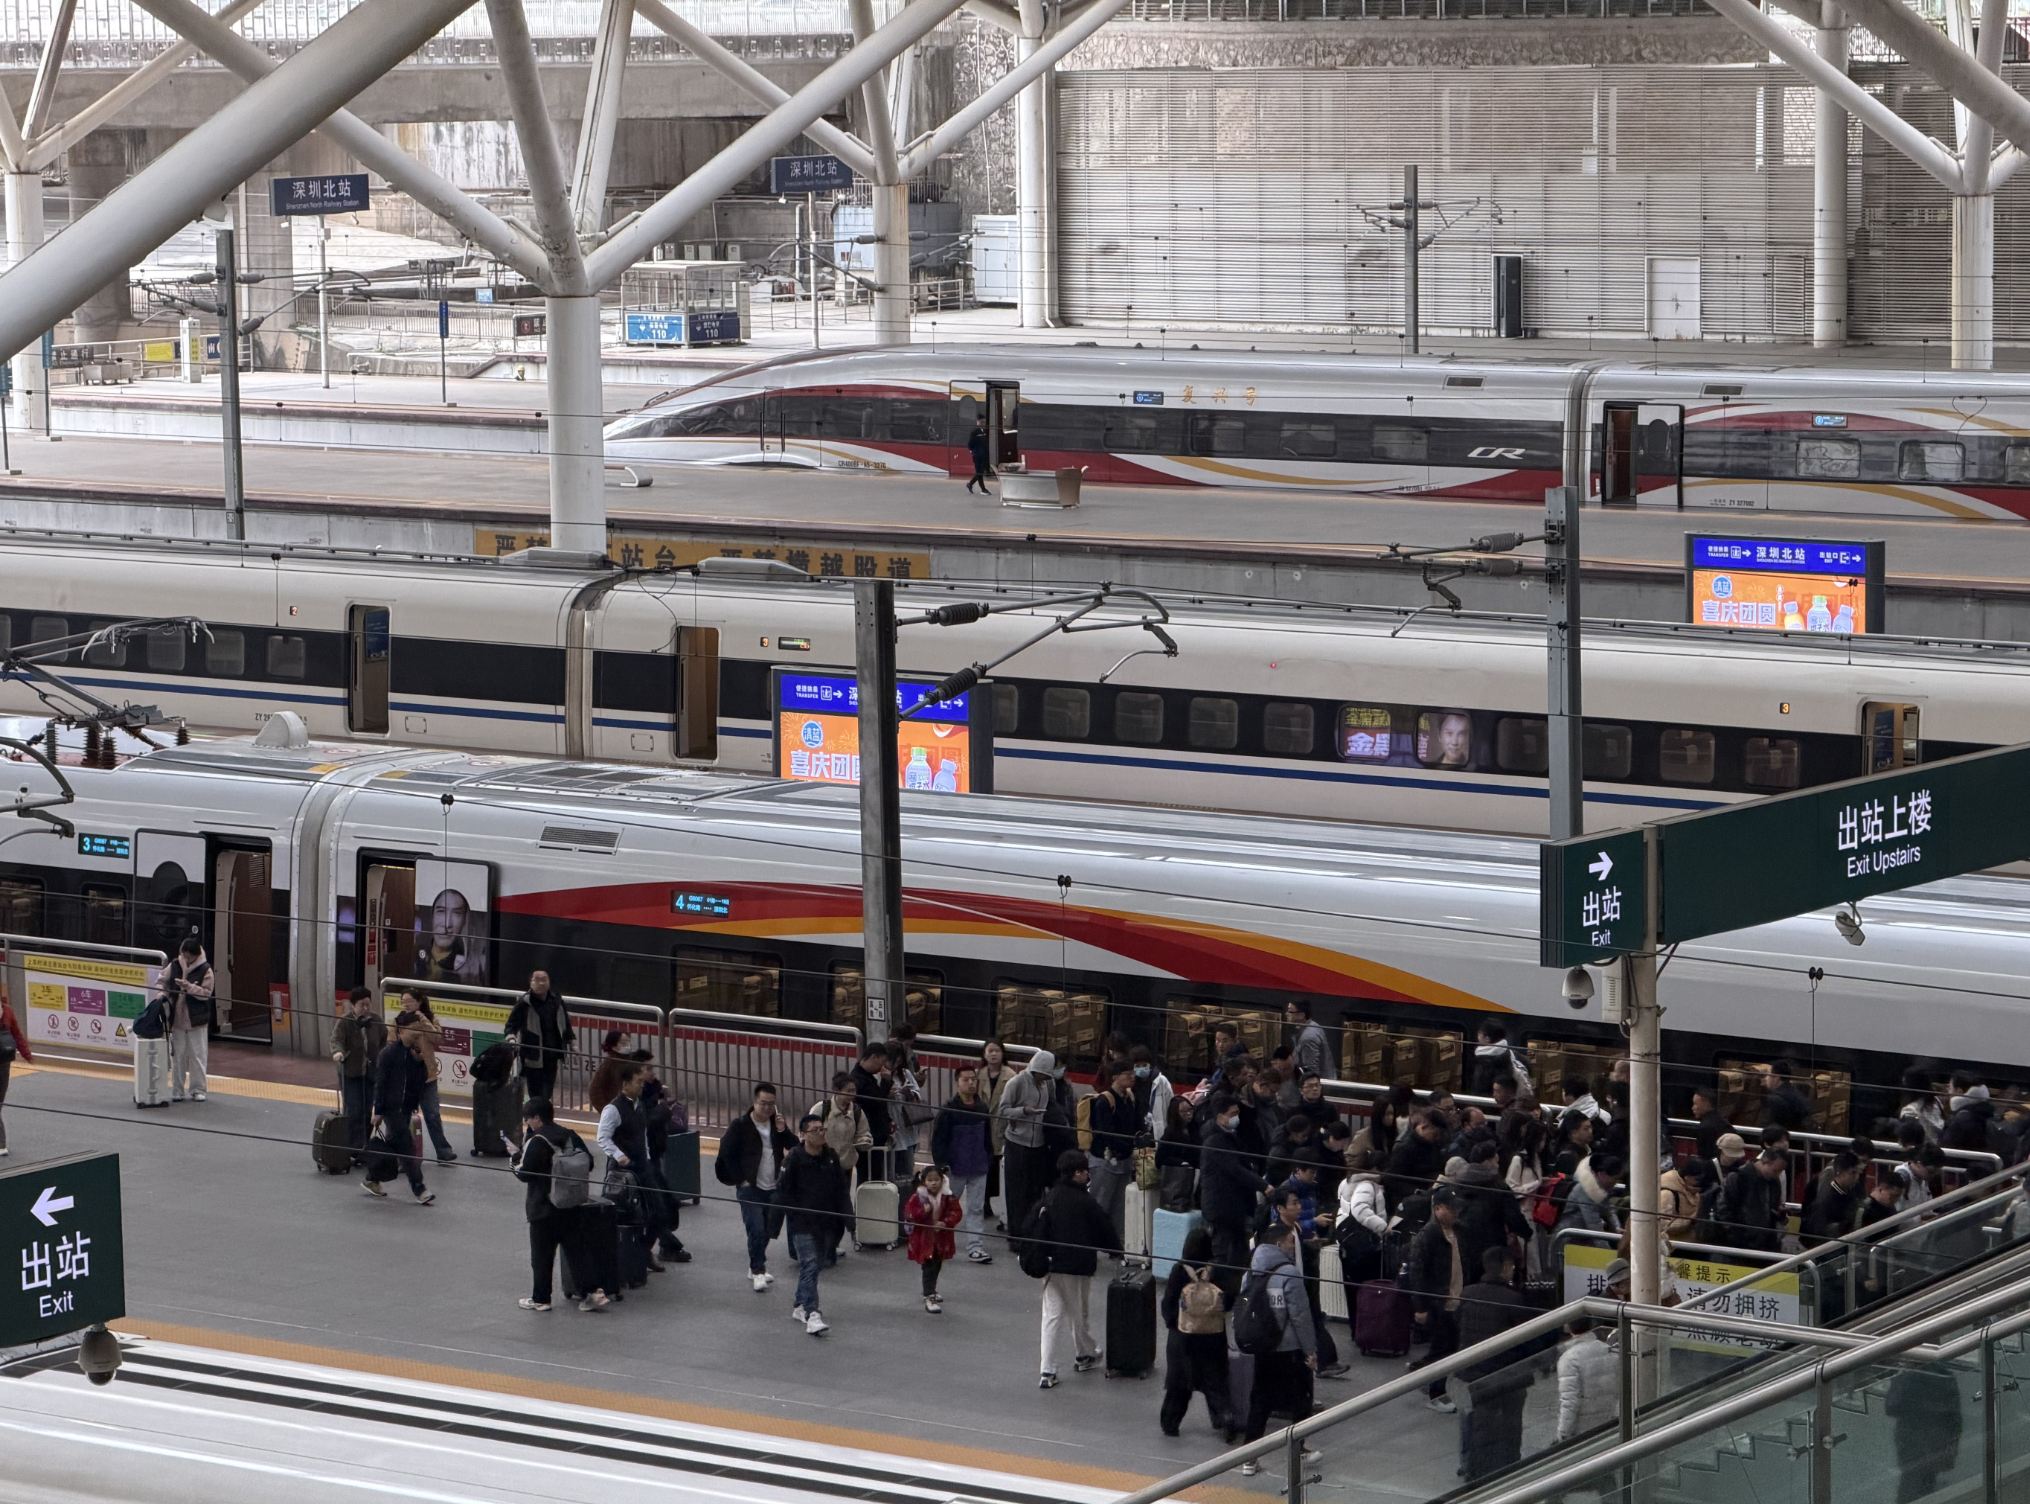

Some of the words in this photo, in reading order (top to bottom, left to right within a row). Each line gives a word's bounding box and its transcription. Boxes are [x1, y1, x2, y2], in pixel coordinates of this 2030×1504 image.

[790, 160, 837, 178] 深圳北站
[292, 179, 351, 199] 深圳北站
[652, 330, 667, 339] 110
[705, 329, 719, 338] 110
[1182, 385, 1258, 406] 复兴号
[1467, 446, 1525, 460] CR
[1757, 546, 1805, 560] 深圳北站
[1702, 600, 1776, 626] 喜庆团圆
[1838, 789, 1931, 850] 出站上楼
[83, 837, 91, 851] 3
[1847, 854, 1870, 878] Exit
[1873, 844, 1921, 875] Upstairs
[675, 894, 684, 909] 4
[1582, 885, 1622, 927] 出站
[1591, 929, 1611, 947] Exit
[21, 1231, 91, 1291] 出站
[1667, 1261, 1731, 1284] 馨提示
[39, 1290, 74, 1318] Exit
